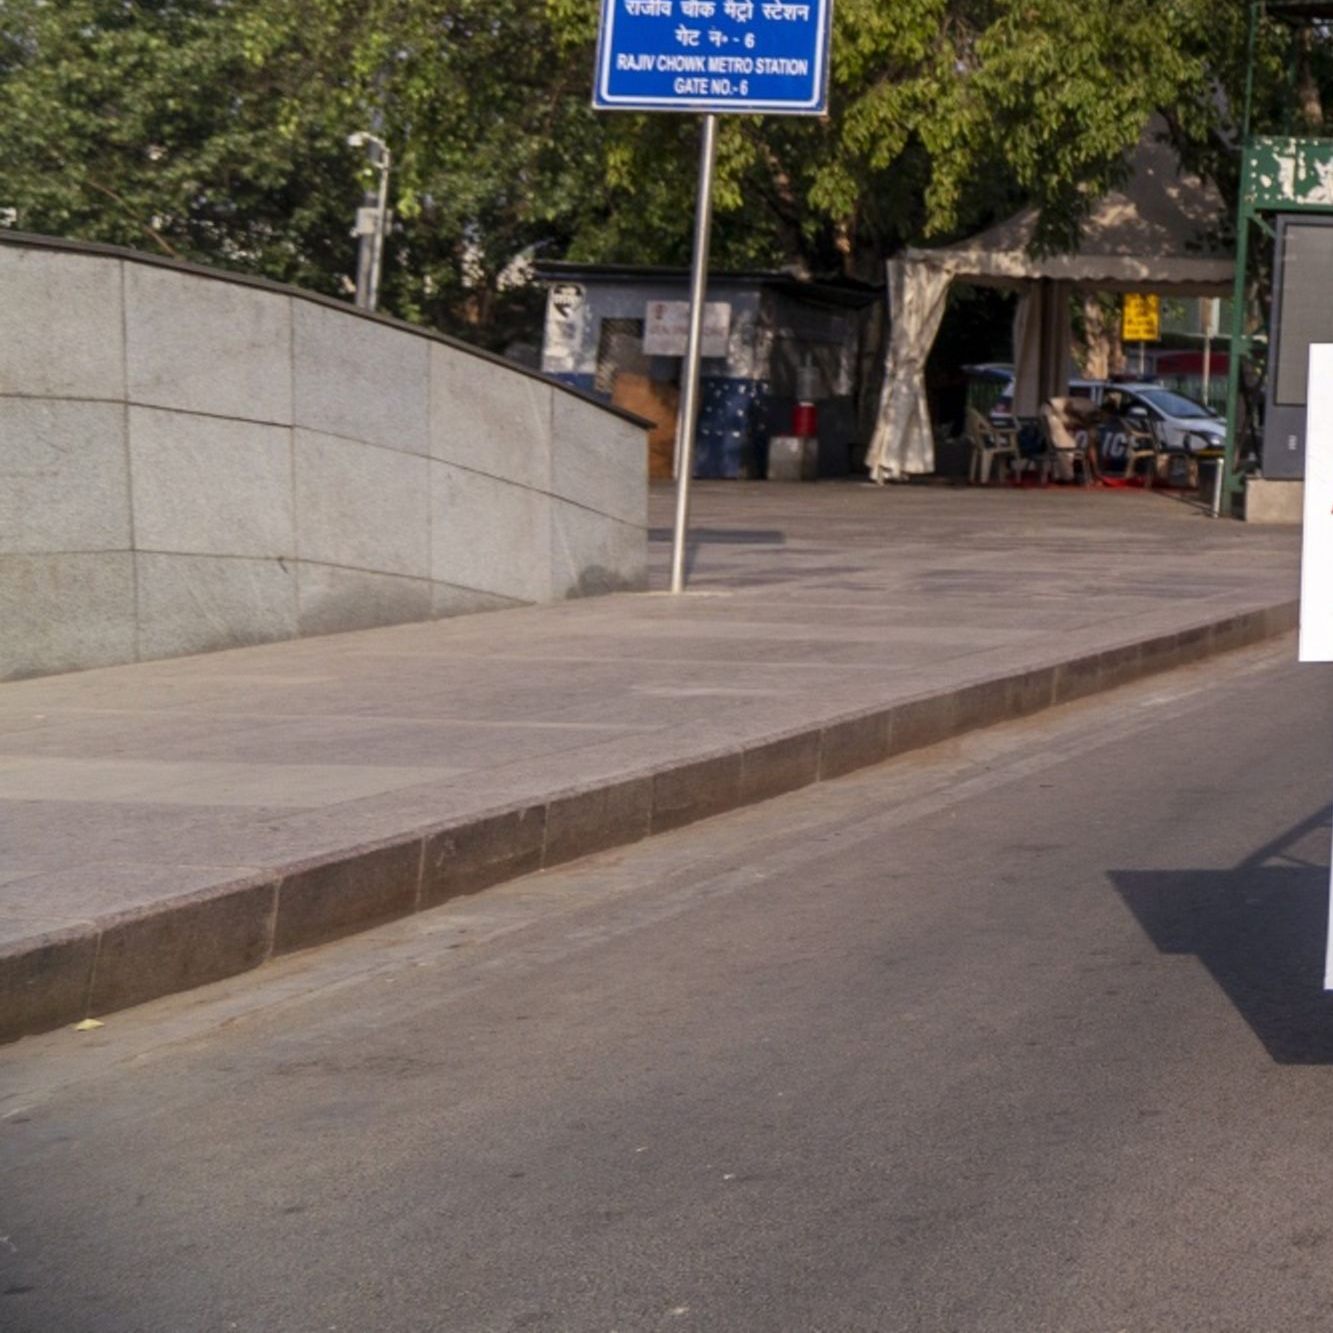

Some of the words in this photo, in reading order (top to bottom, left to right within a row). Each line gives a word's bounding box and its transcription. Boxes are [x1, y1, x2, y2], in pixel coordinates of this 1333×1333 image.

[675, 24, 700, 46] गेट
[617, 53, 657, 71] RAJIV
[657, 55, 706, 73] CHOWK
[708, 57, 753, 75] METRO
[755, 58, 808, 76] STATION
[674, 78, 709, 95] GATE
